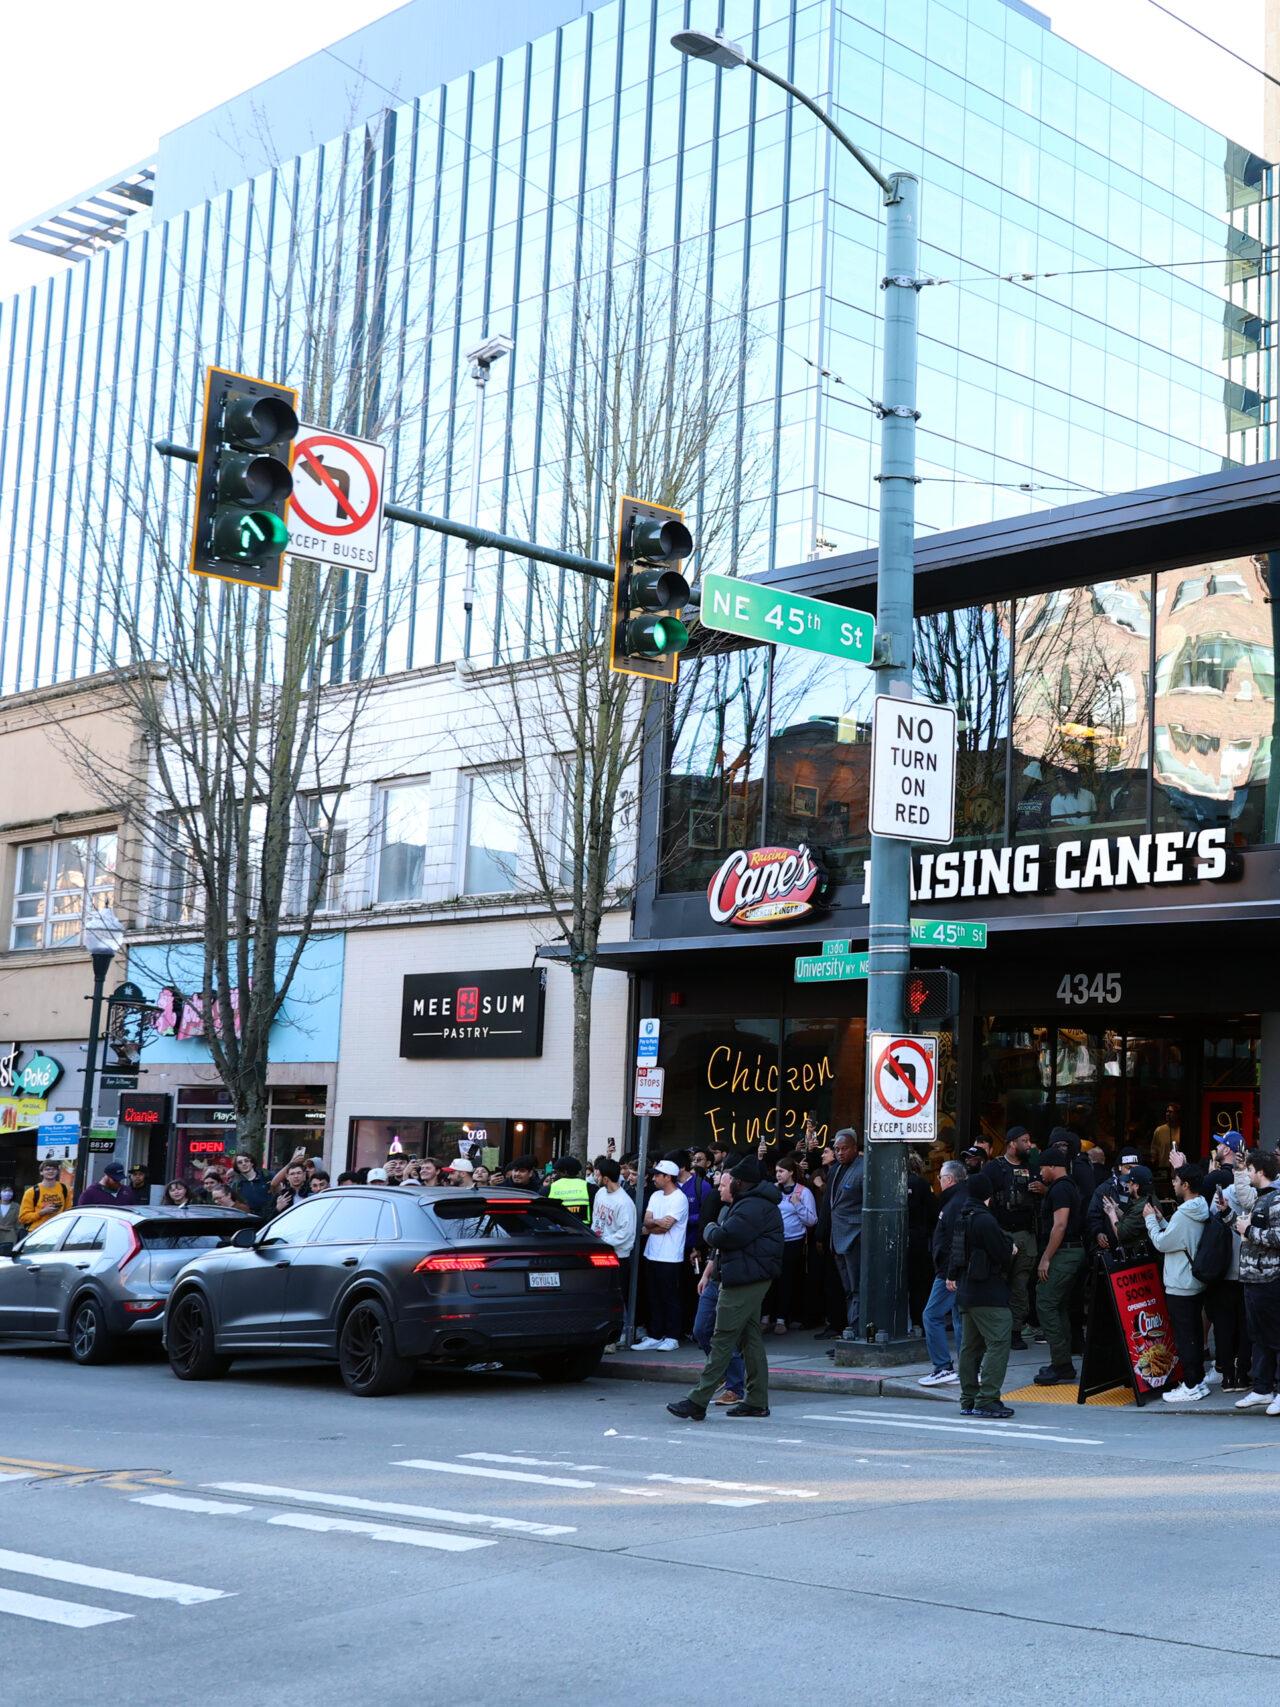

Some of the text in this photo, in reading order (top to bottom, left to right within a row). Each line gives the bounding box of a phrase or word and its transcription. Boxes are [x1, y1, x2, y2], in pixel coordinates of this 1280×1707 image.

[288, 532, 374, 563] XCEPT BUSES
[713, 589, 863, 649] NE 45th St
[897, 714, 933, 743] NO
[891, 746, 937, 772] TURN
[901, 776, 925, 798] ON
[895, 802, 930, 825] RED
[749, 850, 788, 866] Raising
[1055, 827, 1226, 889] CANE'S
[709, 843, 818, 923] Cane's
[911, 924, 983, 943] NE 45th St
[796, 957, 844, 980] University
[1056, 972, 1122, 1005] 4345
[413, 998, 451, 1016] MEE
[482, 994, 525, 1015] SUM
[443, 1027, 490, 1039] PASTRY
[23, 1063, 51, 1088] Poké
[872, 1122, 933, 1134] EXCEPT BUSES
[190, 1142, 225, 1153] OPEN
[1116, 1271, 1153, 1288] COMING
[1125, 1286, 1152, 1300] SOON
[1138, 1310, 1163, 1337] Cane's
